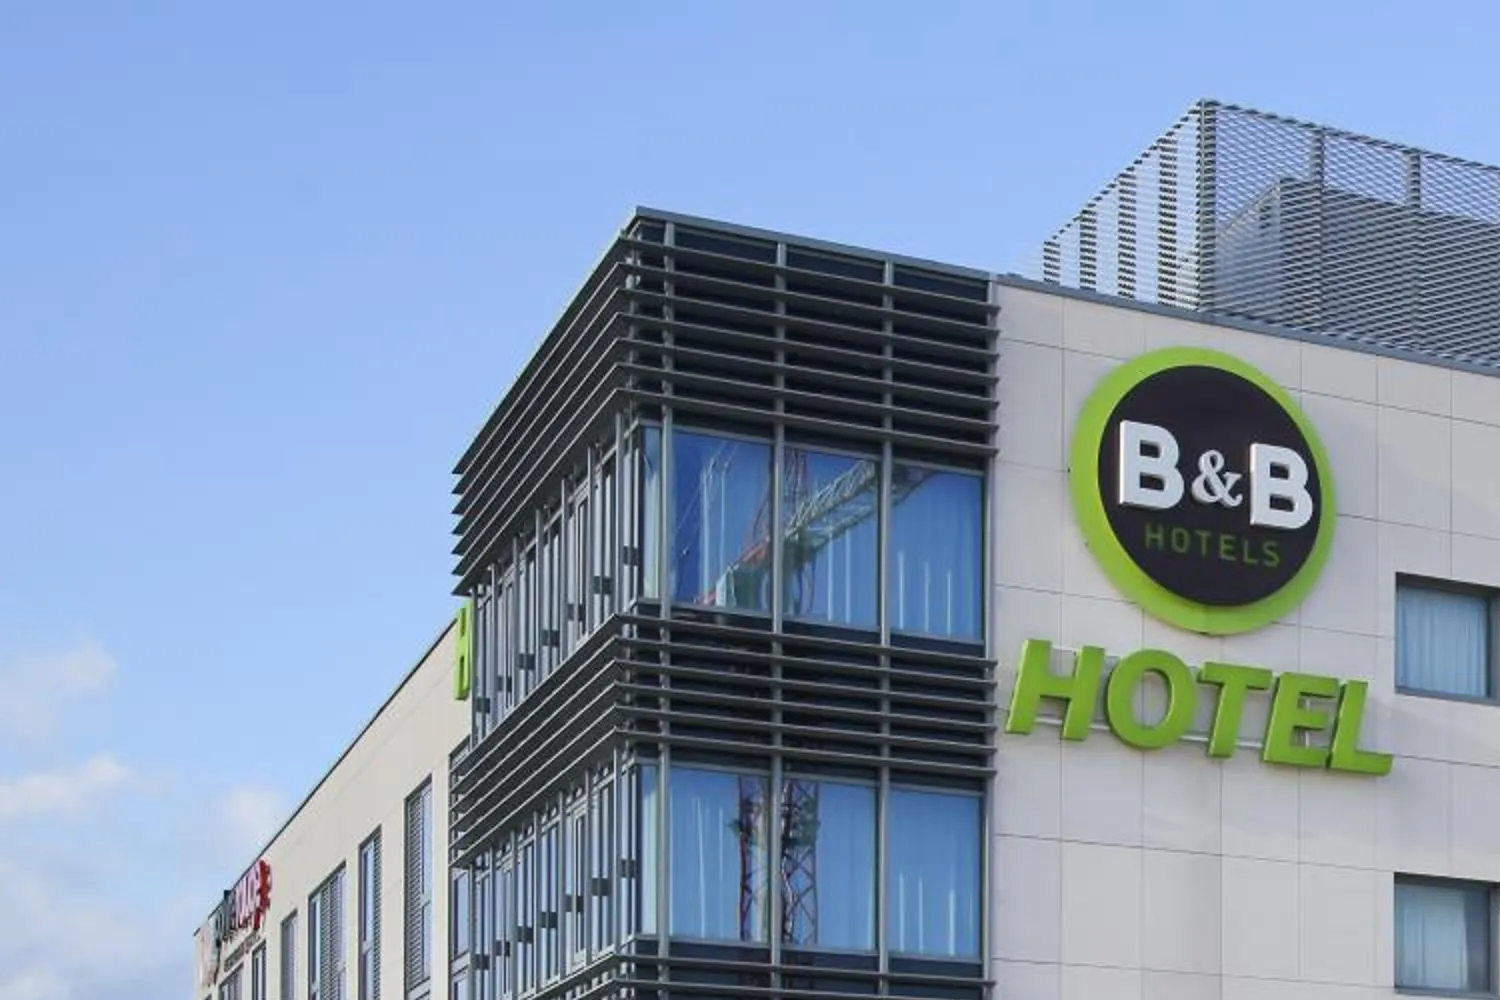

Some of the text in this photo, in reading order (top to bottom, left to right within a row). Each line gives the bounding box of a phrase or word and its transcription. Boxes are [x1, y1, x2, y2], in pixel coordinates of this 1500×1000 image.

[1118, 420, 1314, 531] B&B
[1144, 523, 1281, 569] HOTELS
[1005, 638, 1394, 776] HOTEL
